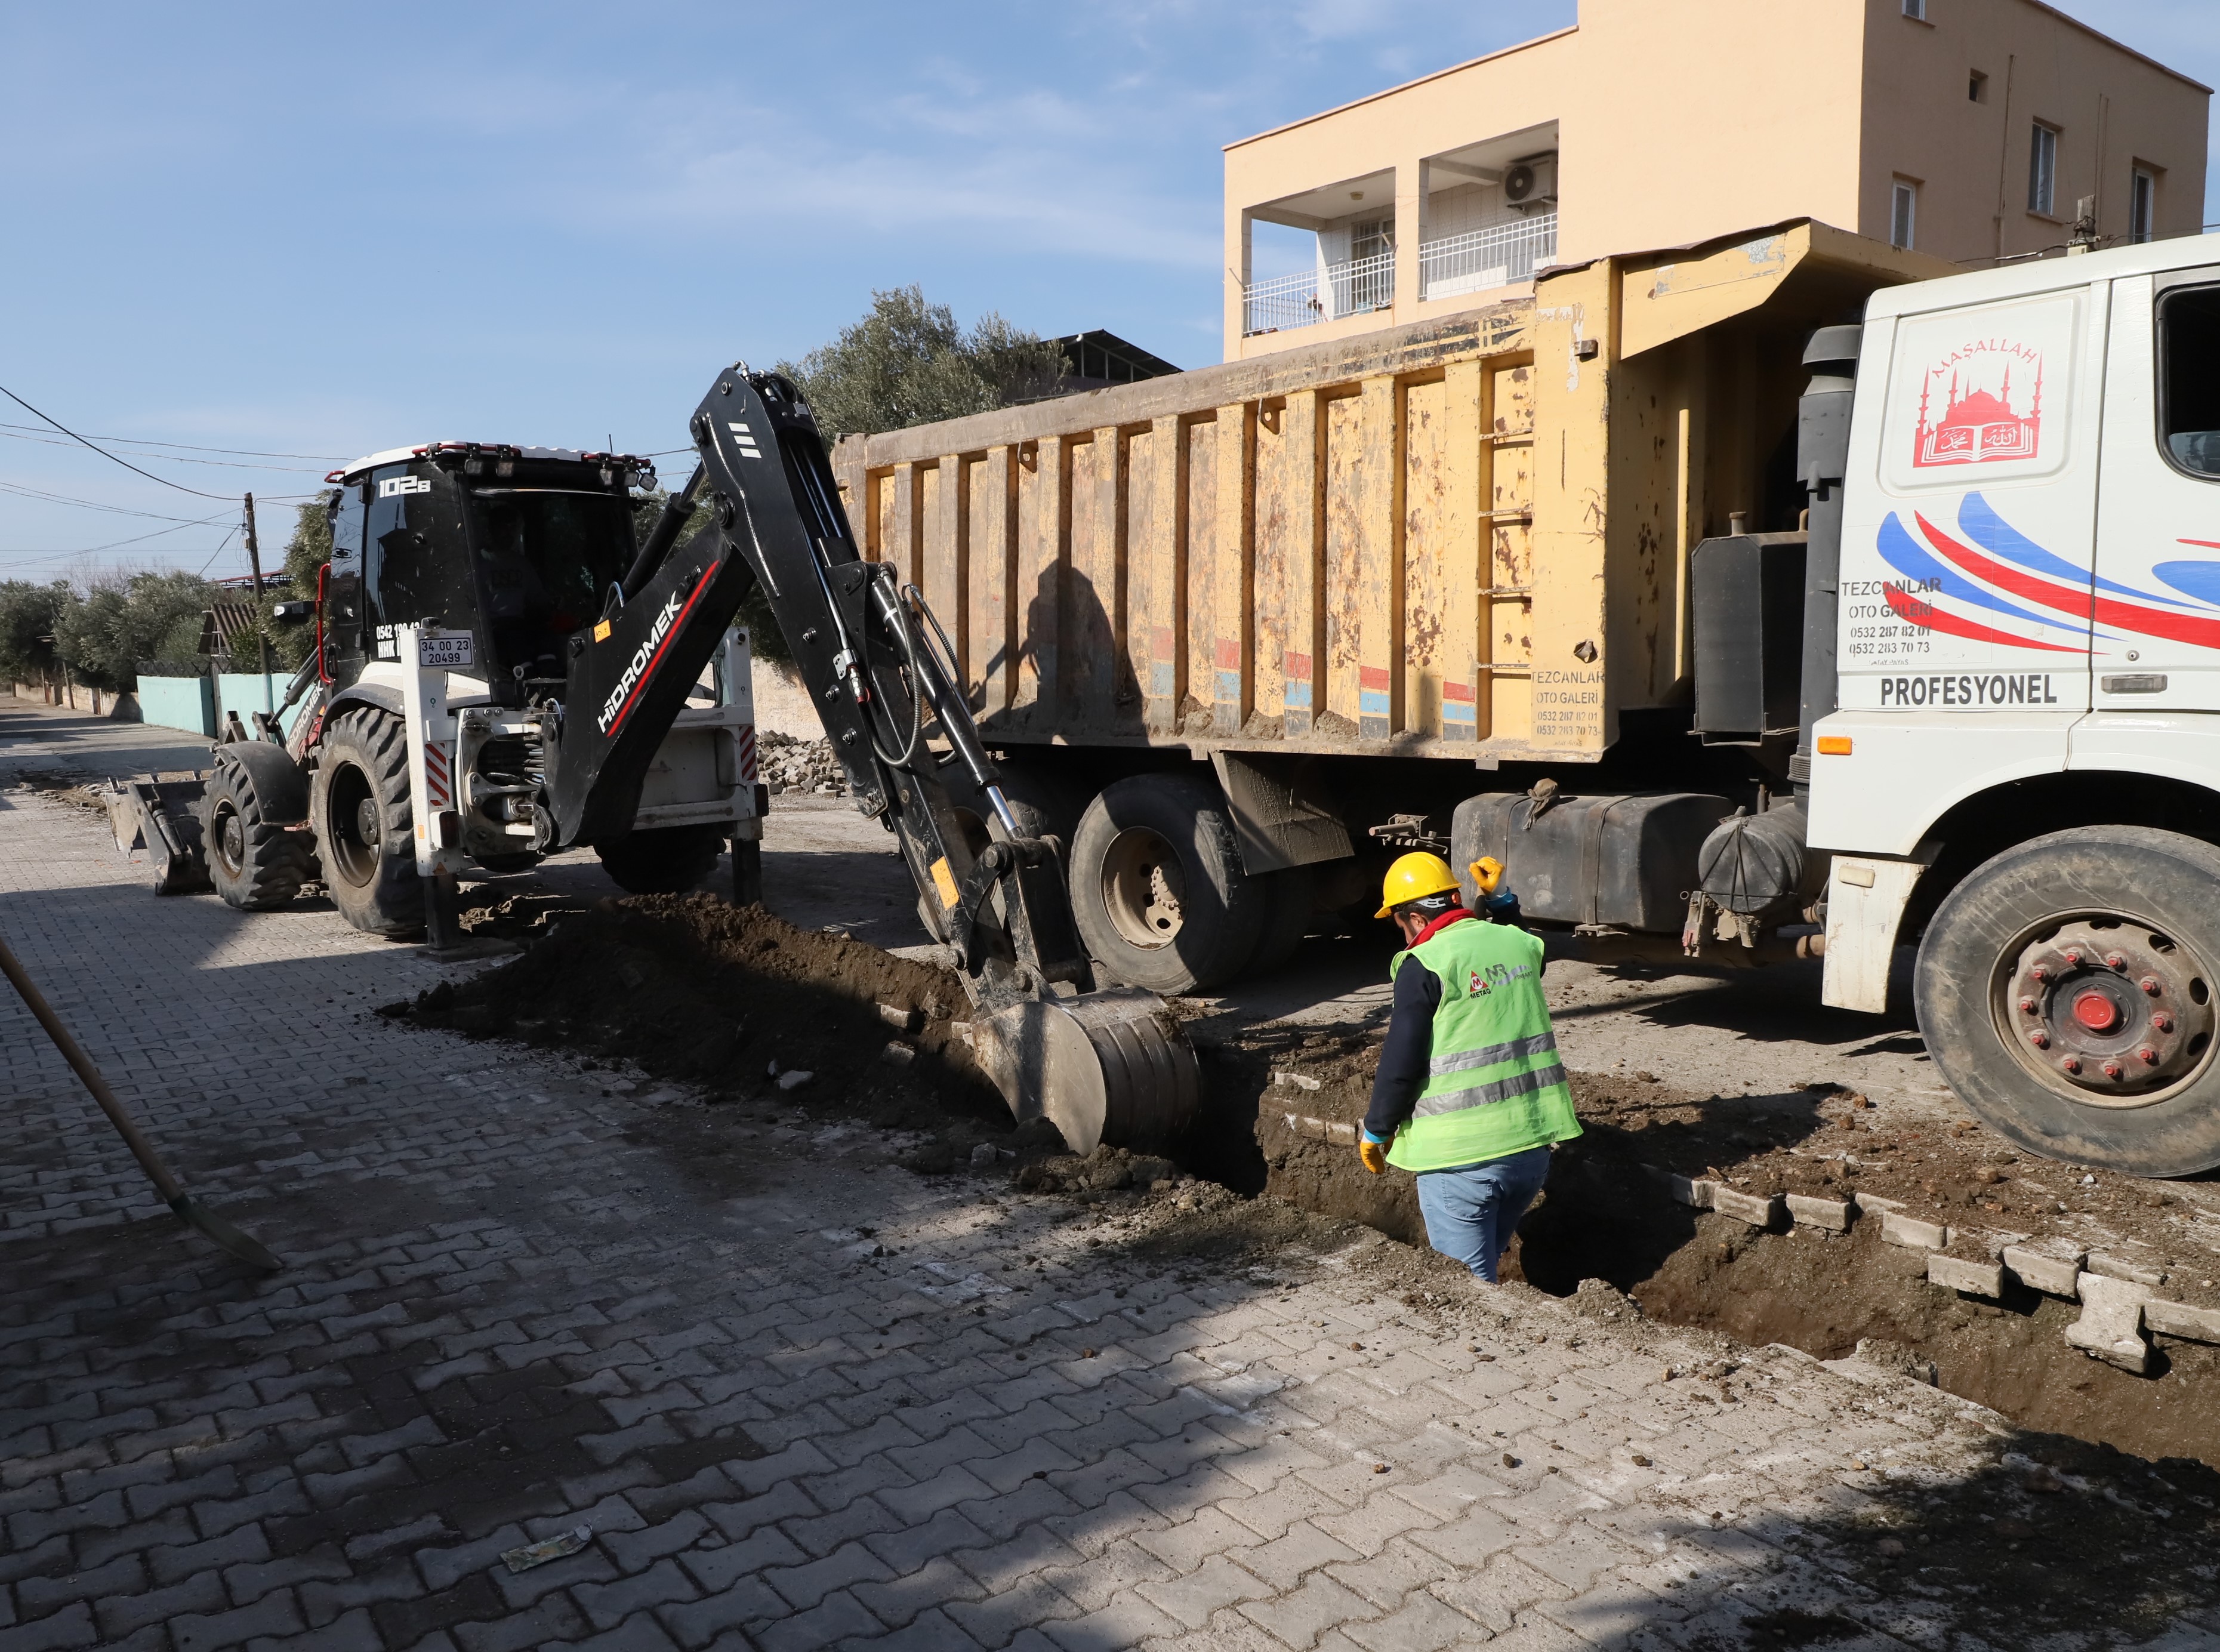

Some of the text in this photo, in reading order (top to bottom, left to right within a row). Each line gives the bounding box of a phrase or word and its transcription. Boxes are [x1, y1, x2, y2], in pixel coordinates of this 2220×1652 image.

[1932, 338, 2037, 379] MAŞALLAH
[379, 475, 431, 498] 102B
[1841, 577, 1942, 596] TEZCANLAR
[1849, 599, 1932, 618] OTO GALERİ
[376, 624, 393, 640] 0542
[1851, 625, 1931, 638] 0532 287 82 01
[378, 640, 396, 659] HHK
[422, 640, 469, 651] 34 00 23
[1849, 642, 1930, 654] 0532 283 70 73
[429, 652, 461, 664] 20499
[1532, 671, 1605, 684] TEZCANLAR
[1881, 674, 2057, 705] PROFESYONEL
[1537, 689, 1598, 704] OTO GALERİ
[1538, 711, 1598, 721] 0532 287 82 01
[1537, 725, 1598, 736] 0532 283 70 73
[1472, 978, 1482, 988] M
[1470, 988, 1491, 999] METAG
